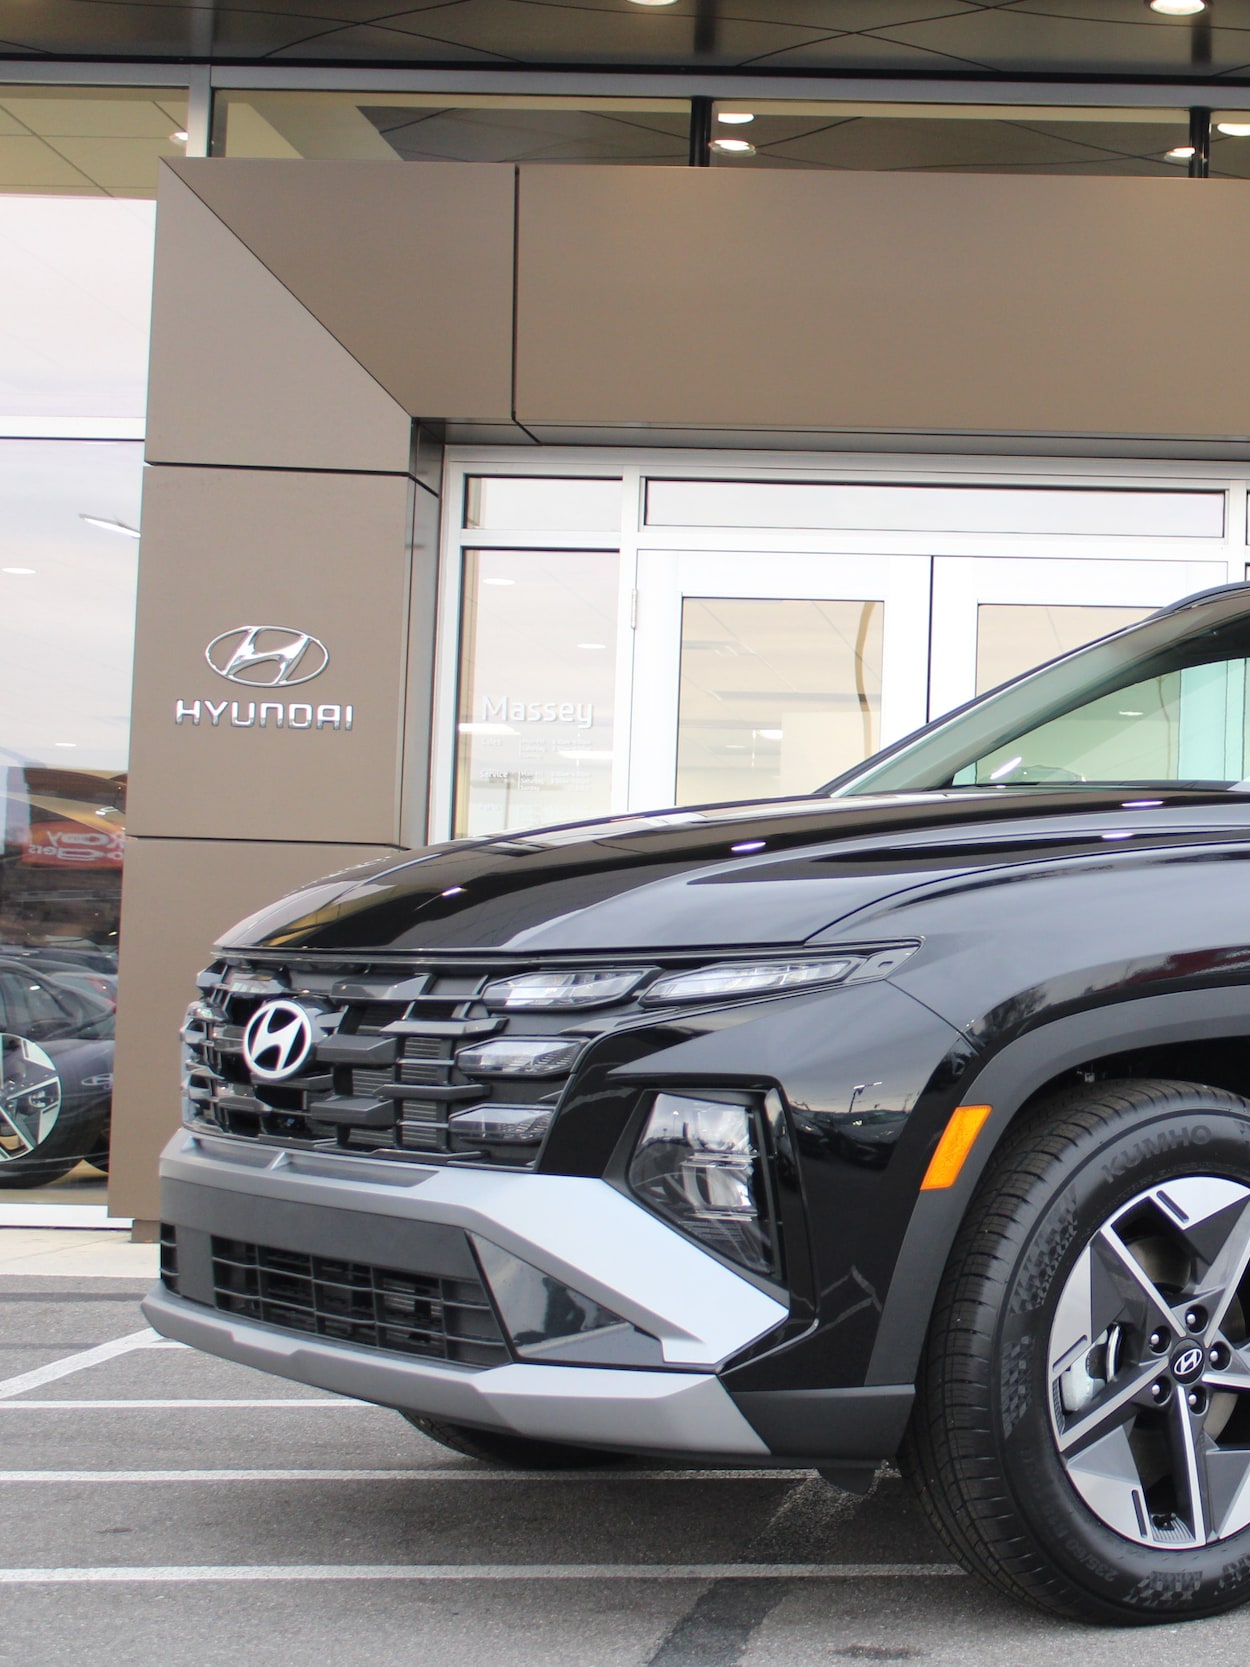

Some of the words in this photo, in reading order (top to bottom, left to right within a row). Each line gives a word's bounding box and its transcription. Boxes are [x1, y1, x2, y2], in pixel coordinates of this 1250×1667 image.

[174, 699, 354, 731] HYUNDAI
[481, 695, 595, 729] Massey
[1101, 1124, 1213, 1184] KUMHO
[1064, 1539, 1120, 1583] 235/60
